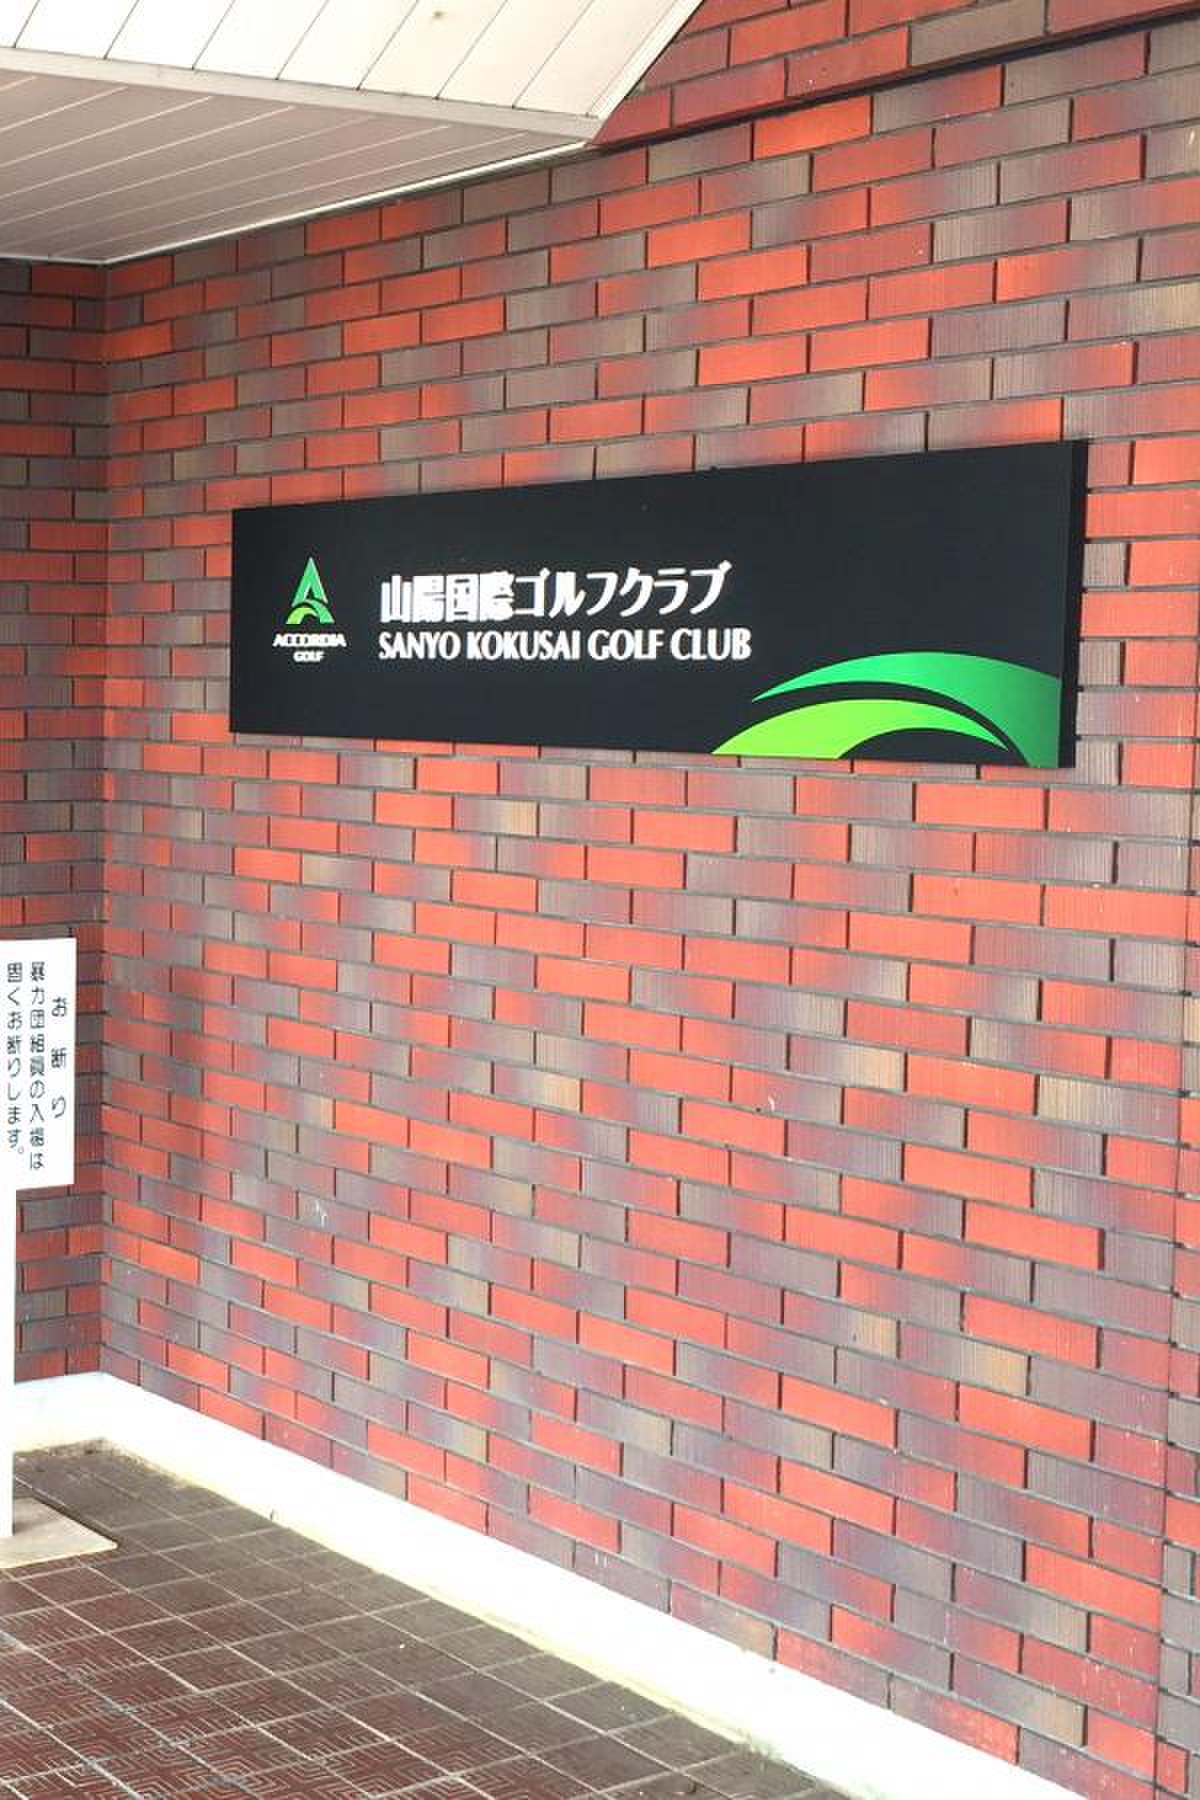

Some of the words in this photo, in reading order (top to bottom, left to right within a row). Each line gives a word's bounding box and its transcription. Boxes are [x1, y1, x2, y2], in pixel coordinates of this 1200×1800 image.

[380, 560, 733, 624] 山陽国際ゴルフクラブ
[272, 632, 348, 648] ACCORDIA
[293, 650, 326, 663] GOLF
[378, 630, 461, 660] SANYO
[466, 629, 582, 660] KOKUSAI
[587, 628, 665, 661] GOLF
[670, 627, 752, 661] CLUB
[50, 995, 68, 1119] お断り
